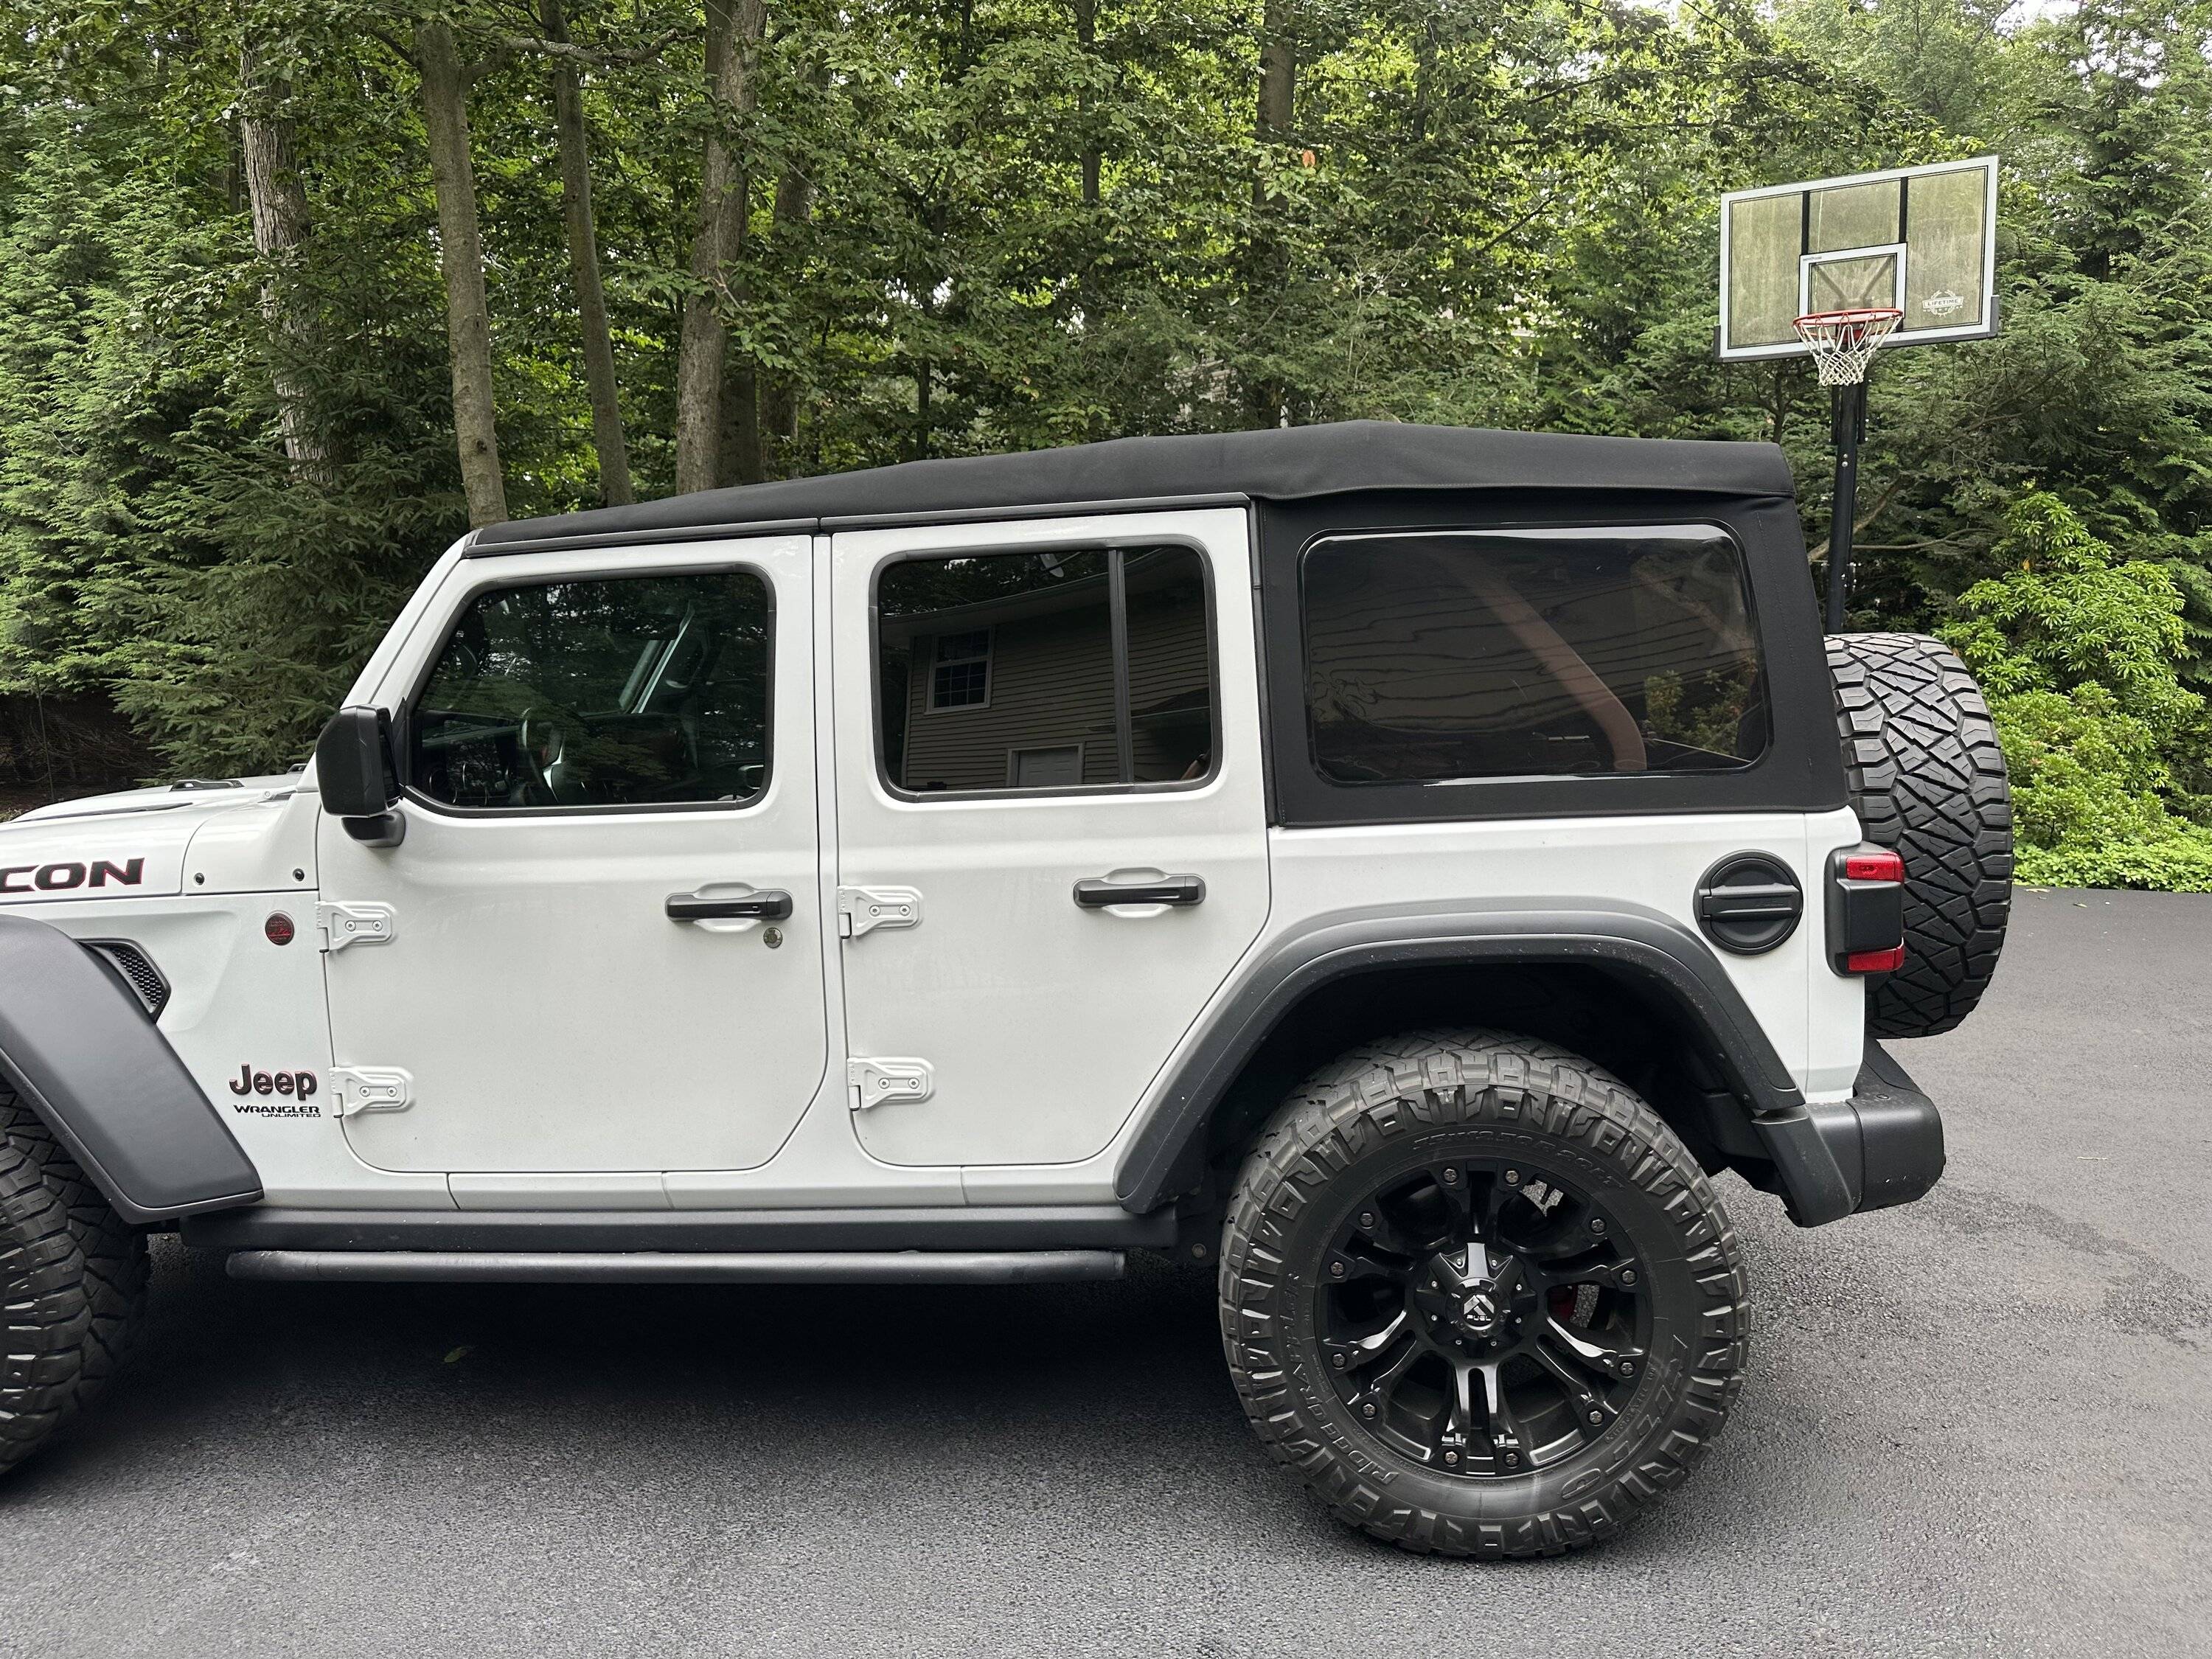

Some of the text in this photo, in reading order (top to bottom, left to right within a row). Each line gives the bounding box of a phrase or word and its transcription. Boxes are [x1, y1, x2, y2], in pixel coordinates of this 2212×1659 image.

[0, 858, 145, 894] CON
[229, 1063, 318, 1101] Jeep
[233, 1105, 321, 1113] WRANGLER
